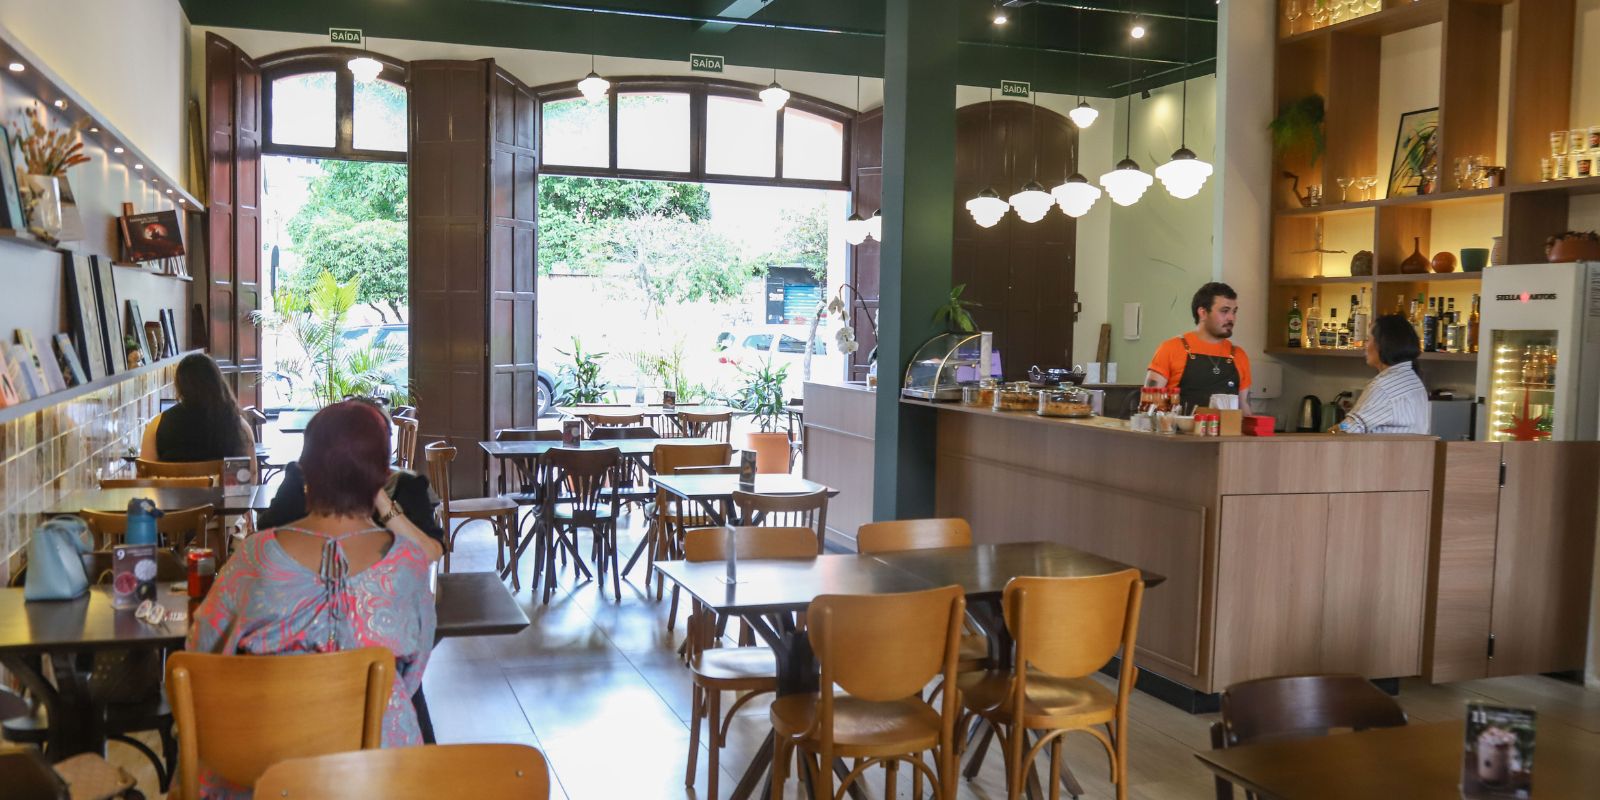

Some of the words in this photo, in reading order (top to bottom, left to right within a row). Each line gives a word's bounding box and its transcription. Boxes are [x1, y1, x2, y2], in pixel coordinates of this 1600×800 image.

[331, 31, 360, 41] SAÍDA
[693, 58, 721, 69] SAÍDA
[1003, 84, 1028, 94] SAÍDA
[117, 549, 125, 560] 9
